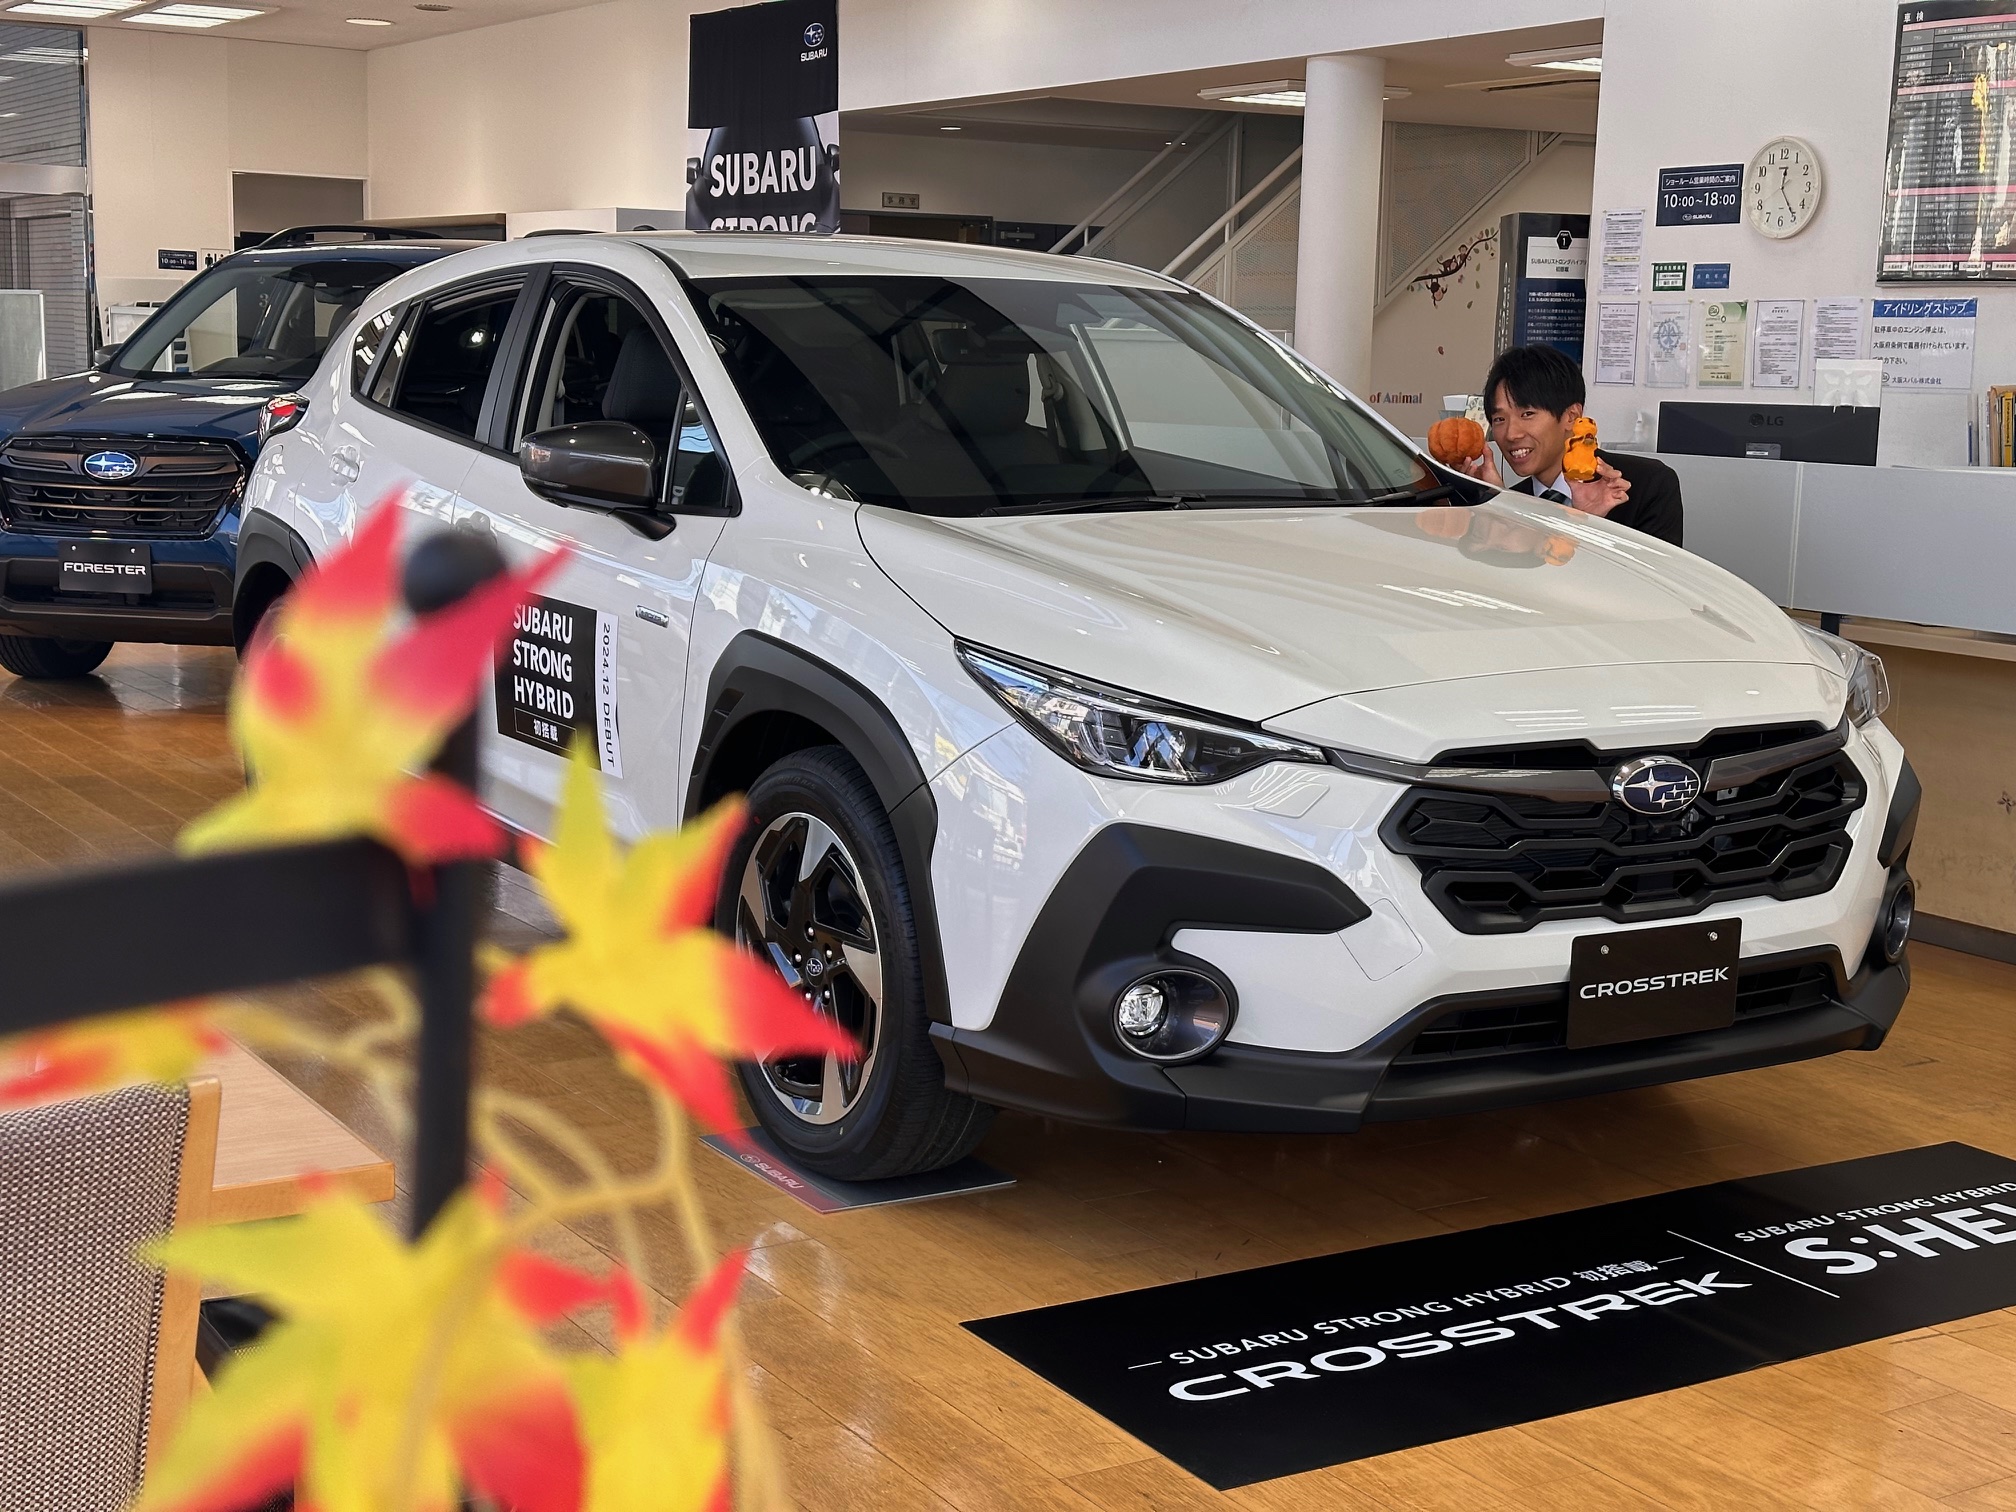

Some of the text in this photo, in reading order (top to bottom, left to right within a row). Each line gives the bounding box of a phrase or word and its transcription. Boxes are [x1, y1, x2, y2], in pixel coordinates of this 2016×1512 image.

[801, 48, 828, 62] SUBARU
[1768, 153, 1775, 165] 11
[1780, 148, 1789, 160] 12
[1795, 152, 1799, 164] 1
[710, 146, 817, 198] SUBARU
[1758, 165, 1767, 178] 10
[1803, 164, 1809, 176] 2
[1754, 182, 1761, 194] 9
[1805, 181, 1812, 193] 3
[1757, 199, 1763, 210] 8
[1799, 198, 1805, 209] 4
[1765, 212, 1771, 223] 7
[1777, 215, 1784, 227] 6
[1790, 212, 1797, 223] 5
[1883, 302, 1966, 317] アイドリングストップ
[1891, 377, 1942, 385] 大阪スバル株式会社
[1369, 392, 1423, 404] of Animal
[1767, 416, 1784, 426] LG
[64, 561, 147, 576] FORESTER
[513, 603, 573, 645] SUBARU
[513, 638, 573, 683] STRONG
[514, 674, 574, 719] HYBRID
[602, 622, 615, 768] 2024.12 DEBUT
[533, 718, 558, 743] 初搭載
[1579, 966, 1730, 1000] CROSSTREK
[754, 1161, 804, 1190] SUBARU
[1734, 1181, 2016, 1243] SUBARU STRONG HYBRID
[1169, 1258, 1658, 1366] SUBARU STRONG HYBRID 初搭載
[1168, 1270, 1754, 1404] CROSSTREK
